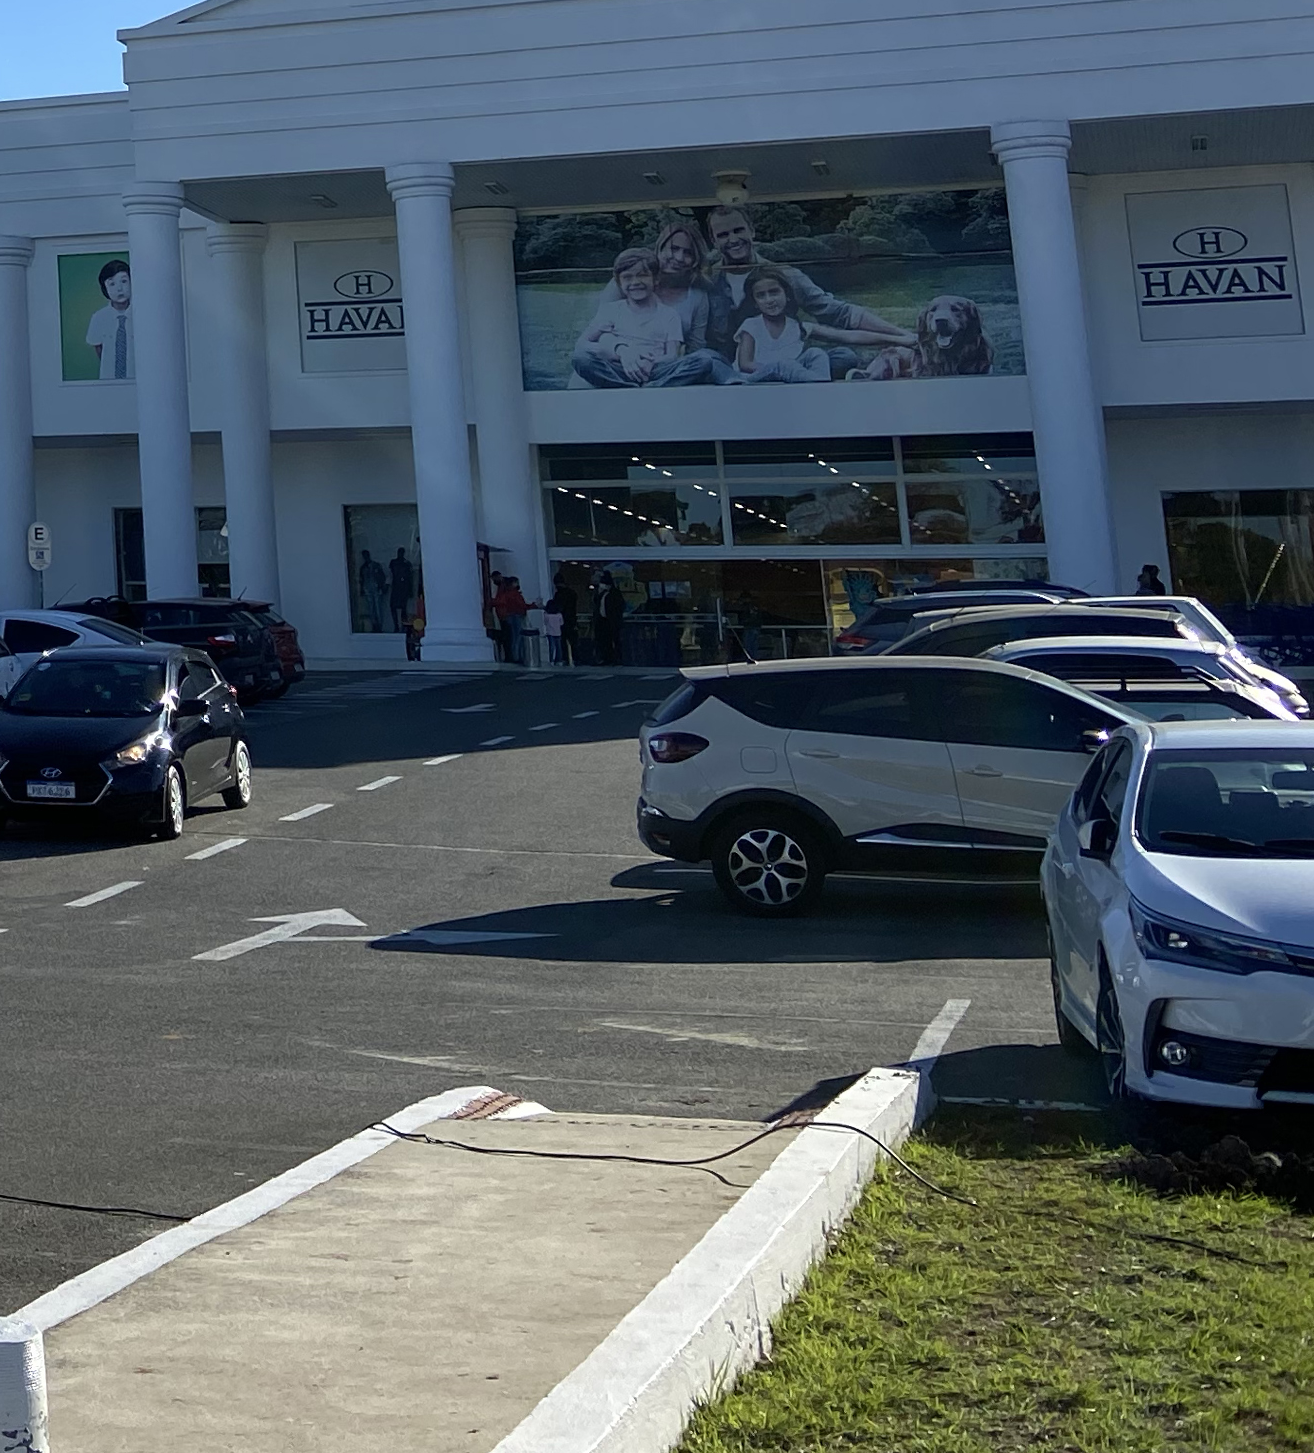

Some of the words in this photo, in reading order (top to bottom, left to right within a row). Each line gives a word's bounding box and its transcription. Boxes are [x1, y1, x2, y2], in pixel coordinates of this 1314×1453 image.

[1196, 231, 1225, 254] H
[352, 274, 374, 295] H
[1141, 264, 1287, 298] HAVAN
[34, 527, 44, 541] E
